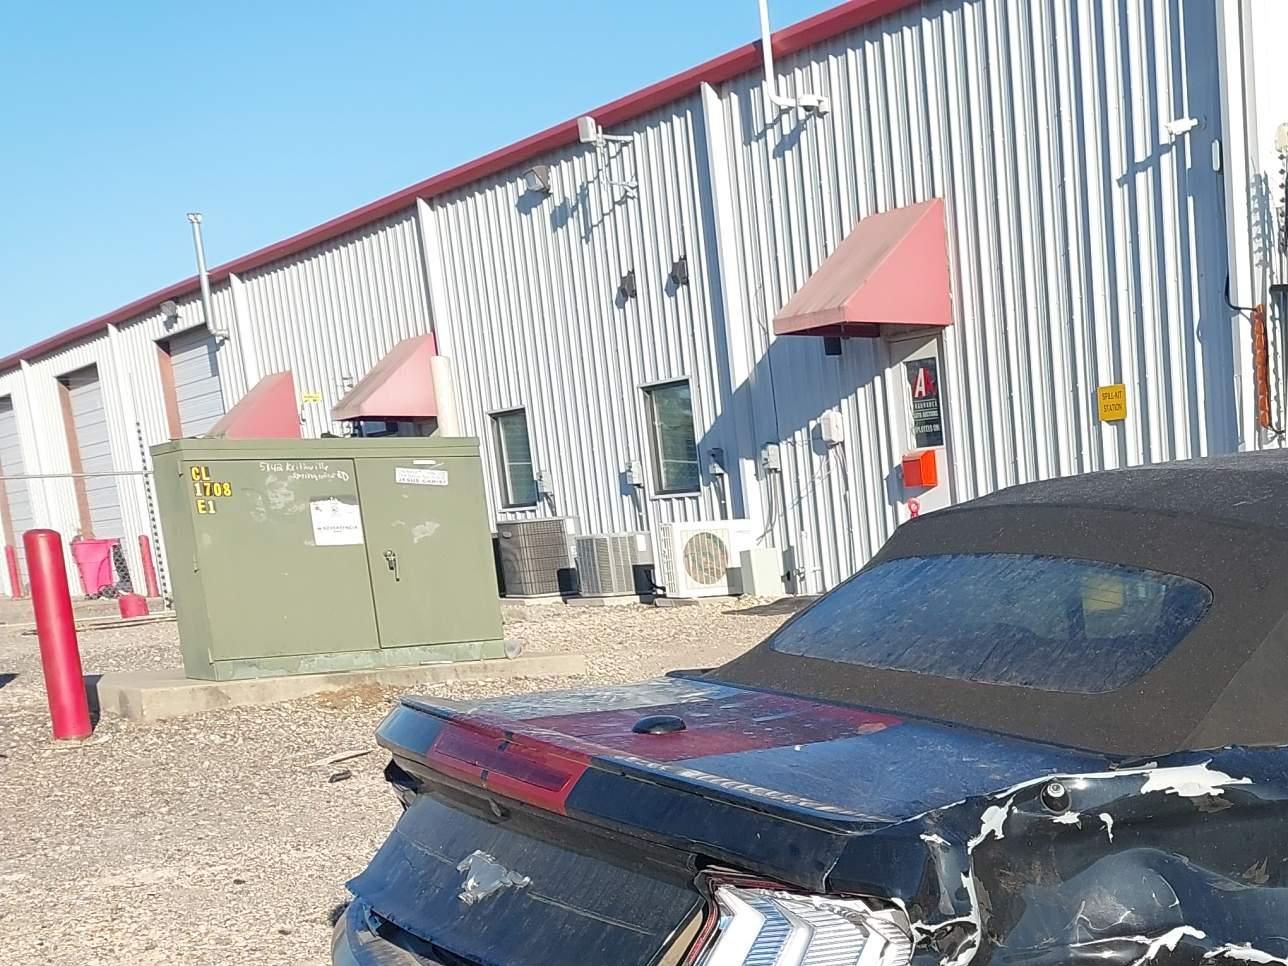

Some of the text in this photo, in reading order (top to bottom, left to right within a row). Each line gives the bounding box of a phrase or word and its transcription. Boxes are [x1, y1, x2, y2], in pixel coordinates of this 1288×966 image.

[191, 466, 210, 481] CL
[194, 482, 232, 497] 1708
[197, 499, 216, 514] E1
